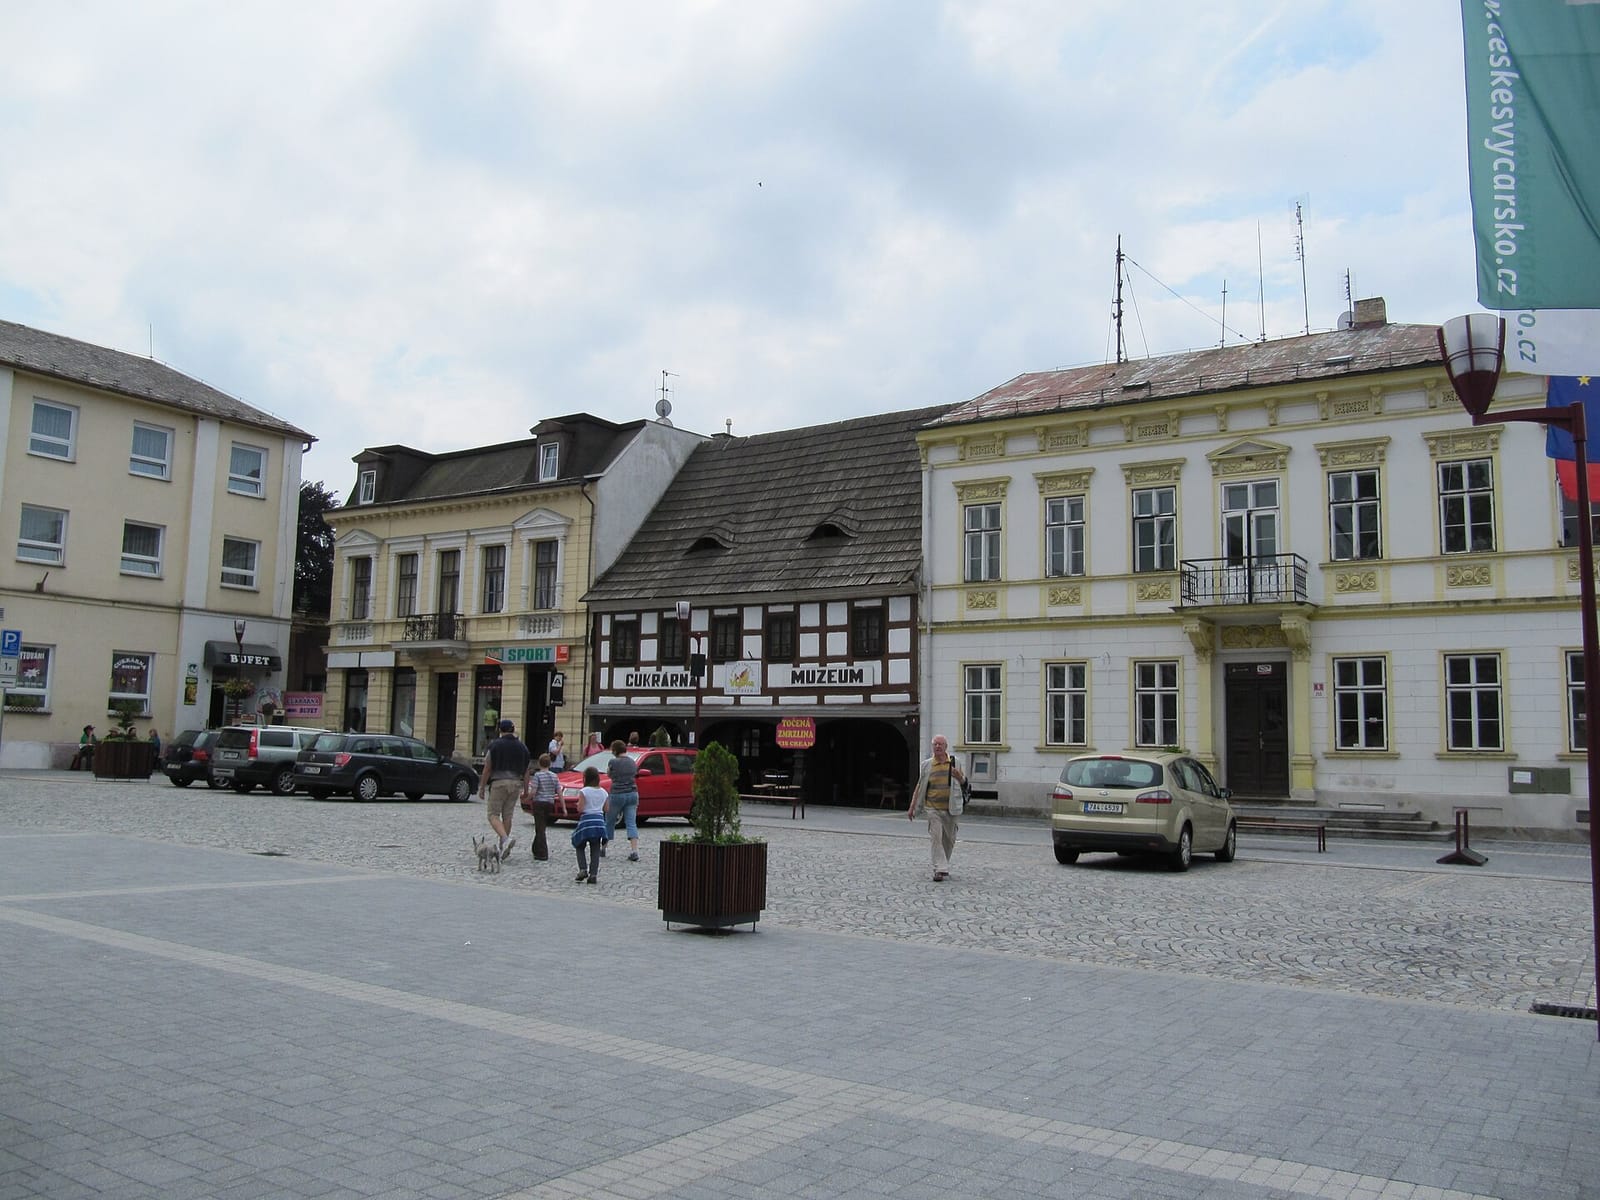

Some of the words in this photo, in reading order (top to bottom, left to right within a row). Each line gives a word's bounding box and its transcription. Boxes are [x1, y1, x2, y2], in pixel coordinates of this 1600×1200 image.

[1517, 310, 1537, 363] o.cz
[4, 632, 17, 648] P
[230, 654, 270, 665] BUFET
[508, 647, 552, 661] SPORT
[791, 668, 864, 684] MUZEUM
[781, 717, 811, 727] TOČENÁ
[777, 730, 814, 738] ZMRZLINA
